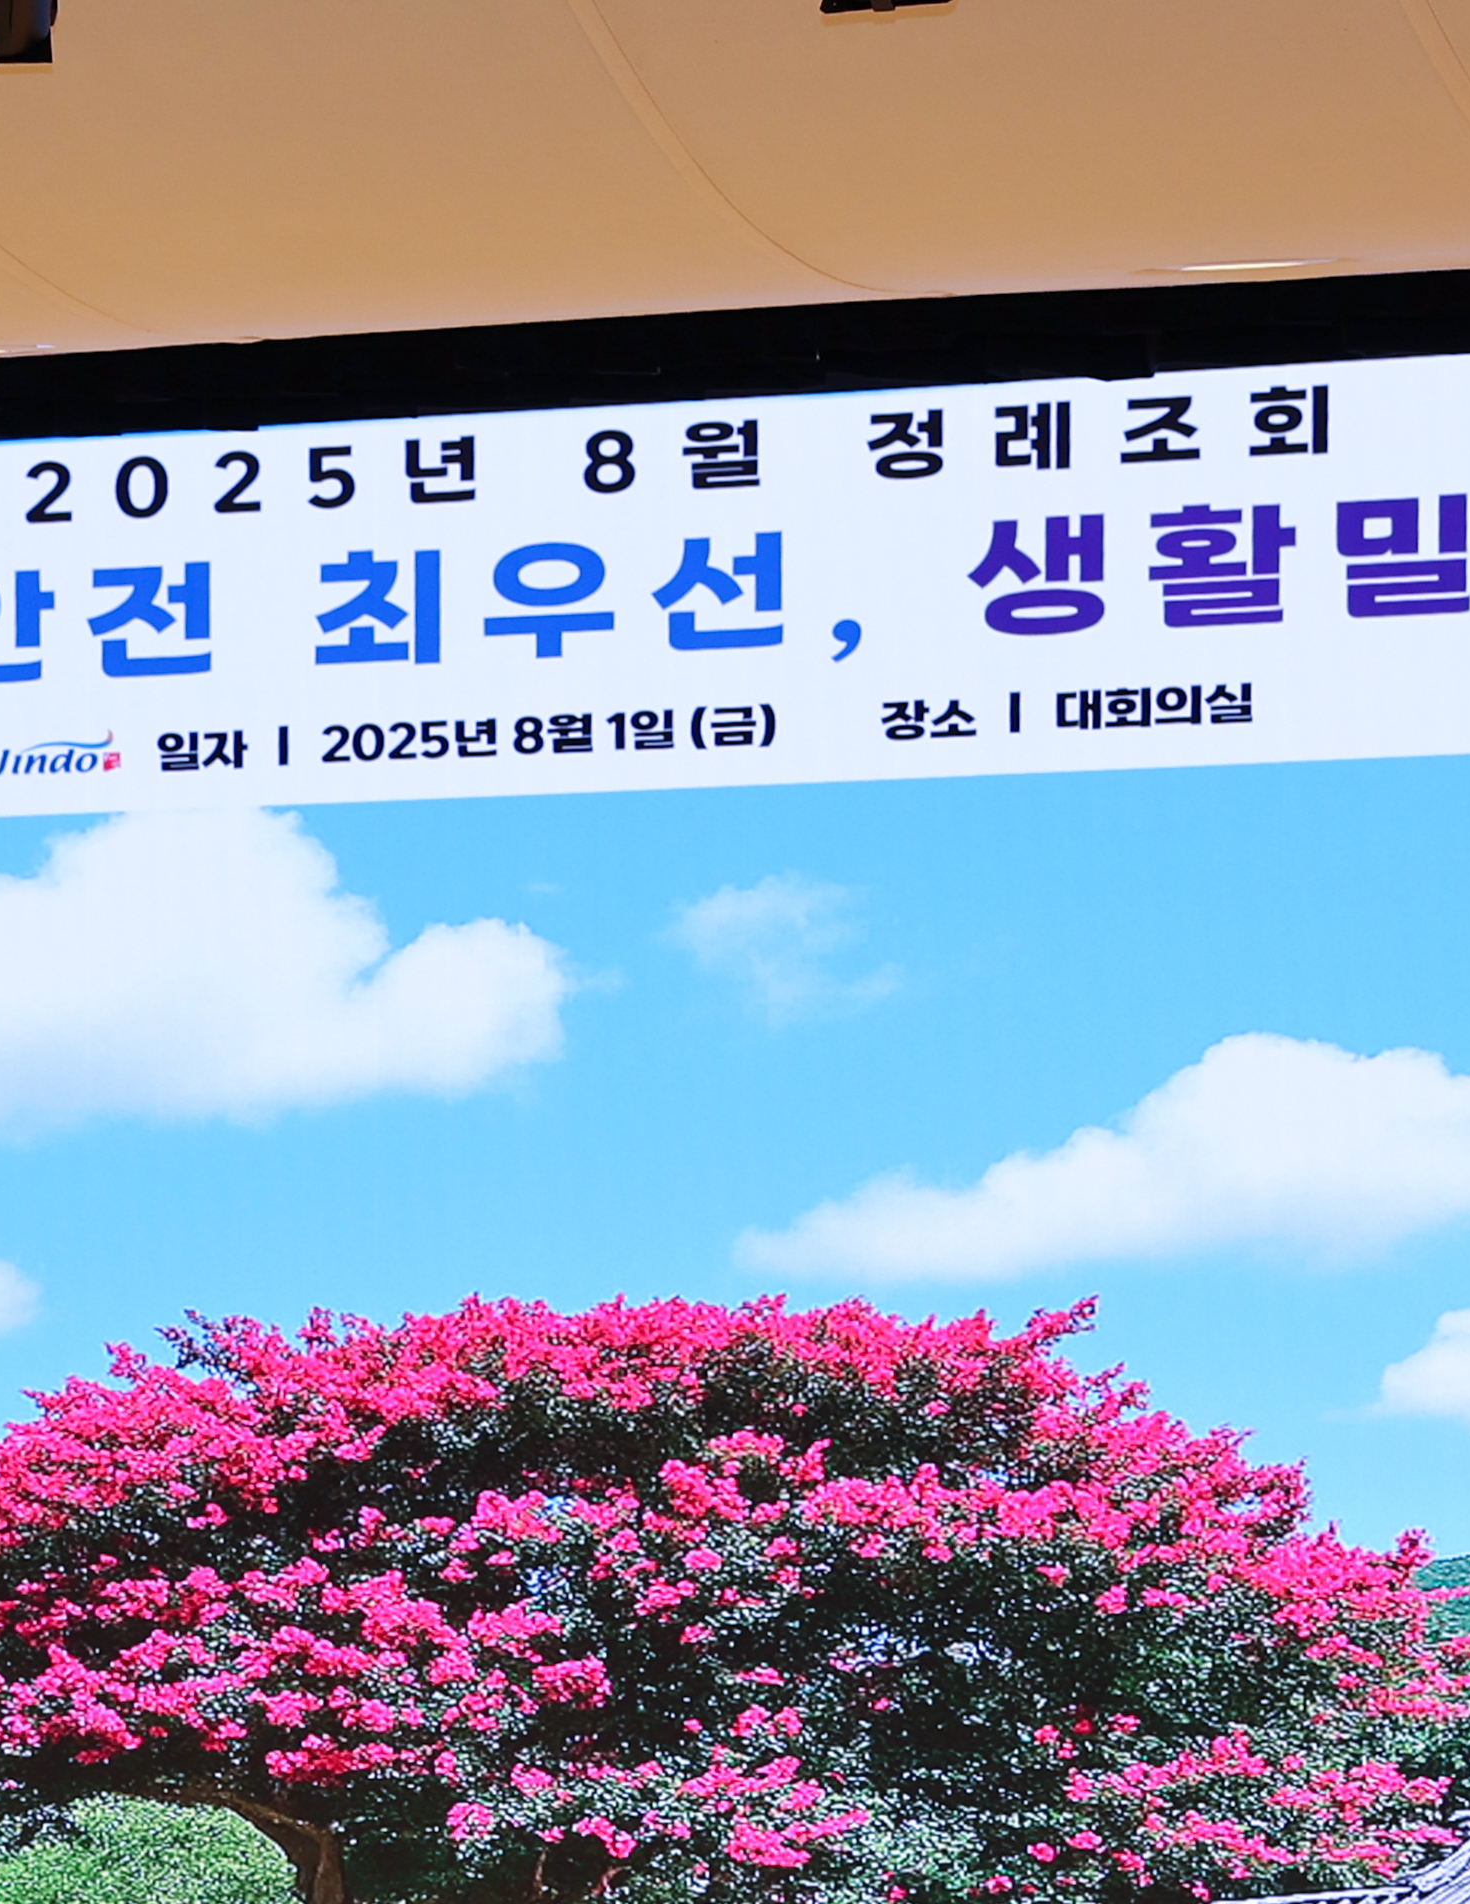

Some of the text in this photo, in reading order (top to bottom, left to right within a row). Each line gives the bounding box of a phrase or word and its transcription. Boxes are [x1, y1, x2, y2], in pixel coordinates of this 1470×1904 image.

[25, 384, 1328, 523] 2025년 8월 정례조회
[315, 531, 861, 665] 최우선,
[157, 730, 248, 771] 일자
[322, 718, 497, 762] 2025년
[513, 713, 593, 754] 8월
[881, 700, 976, 740] 장소
[1056, 683, 1252, 729] 대회의실
